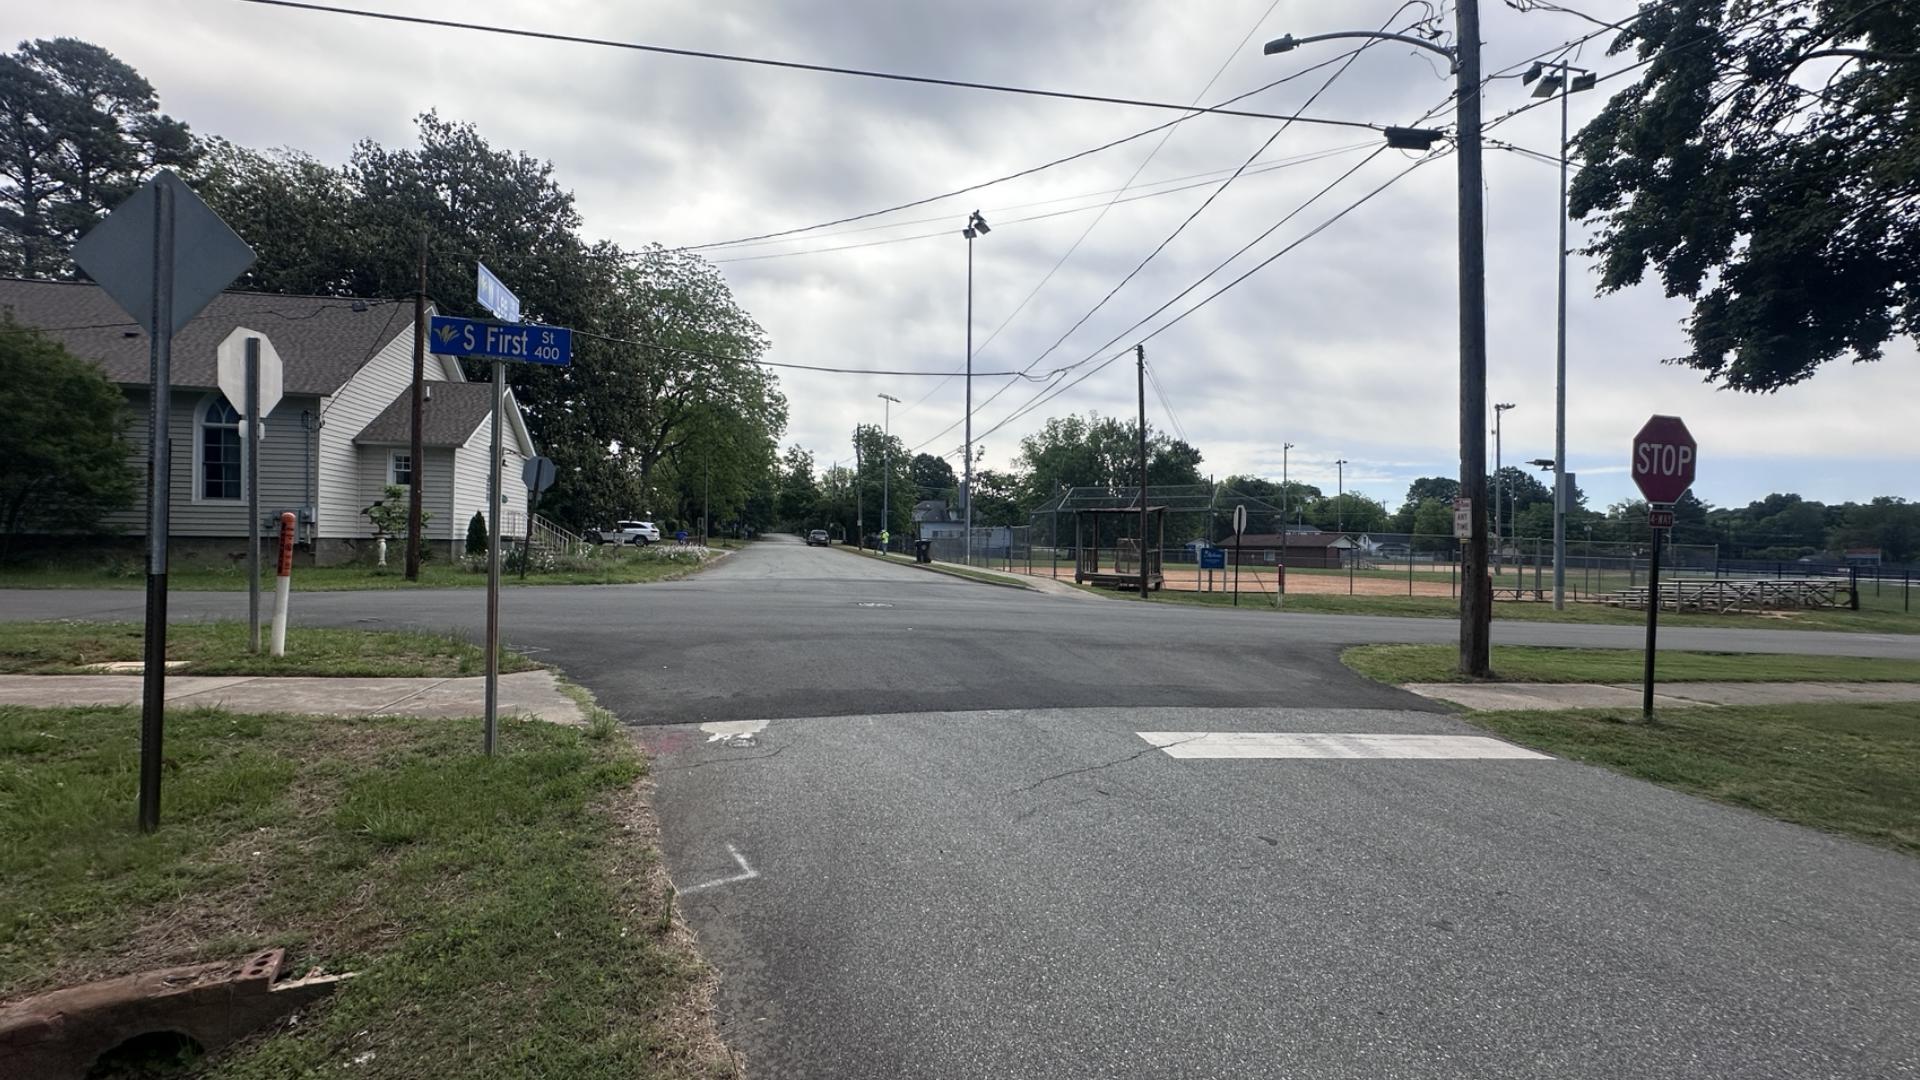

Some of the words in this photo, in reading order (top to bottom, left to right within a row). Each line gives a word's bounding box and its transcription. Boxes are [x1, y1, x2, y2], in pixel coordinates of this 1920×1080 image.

[463, 324, 475, 350] S
[486, 326, 528, 356] First
[542, 331, 554, 345] St
[534, 346, 560, 360] 400
[1636, 442, 1692, 476] STOP
[1457, 513, 1468, 521] ANY
